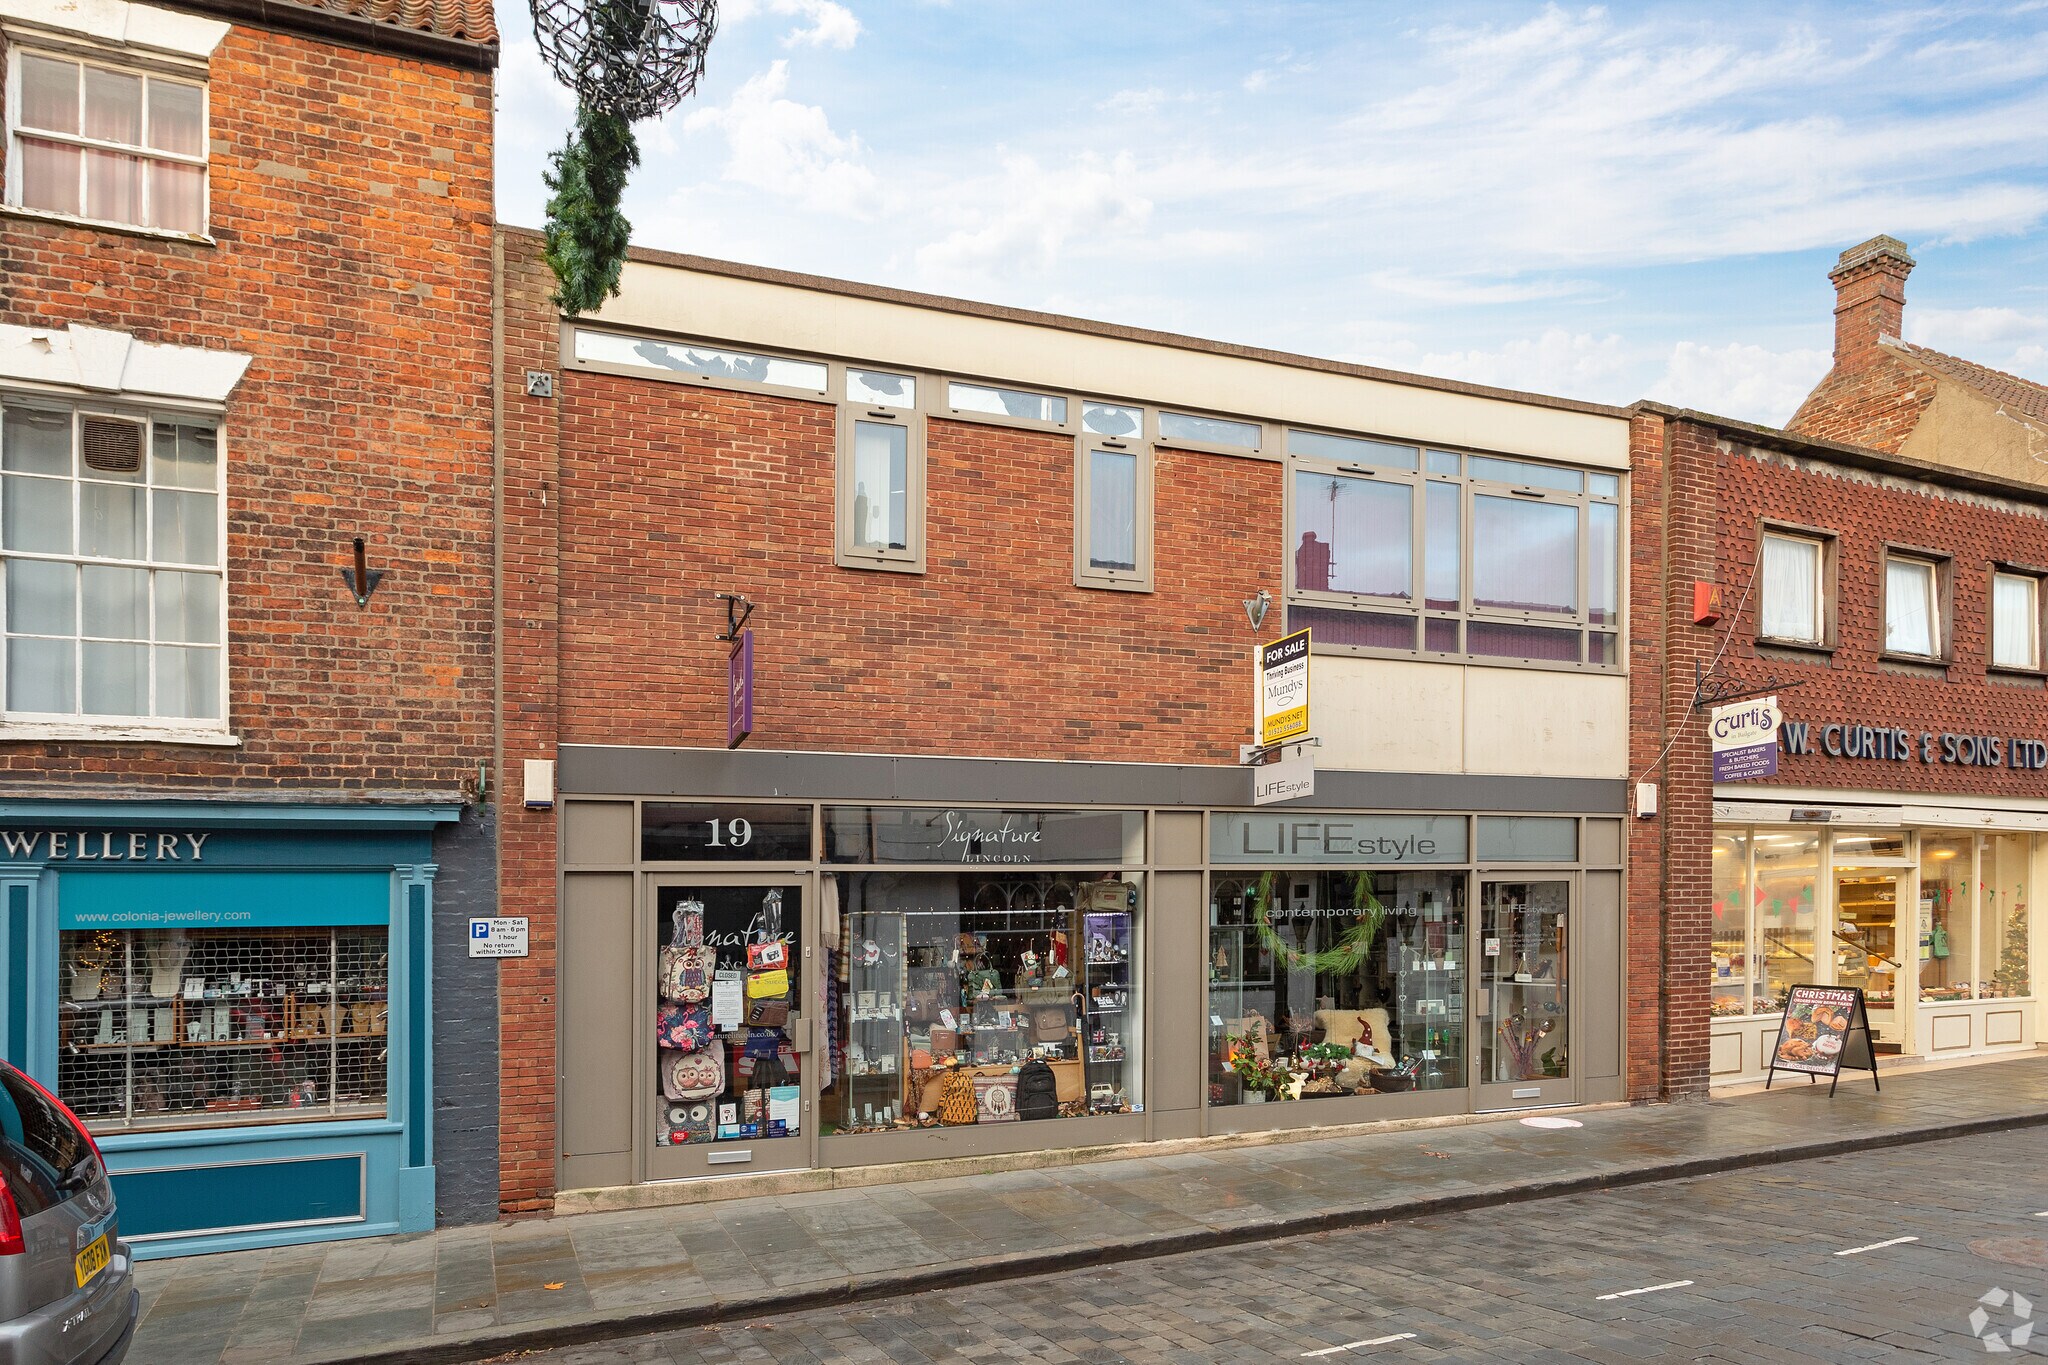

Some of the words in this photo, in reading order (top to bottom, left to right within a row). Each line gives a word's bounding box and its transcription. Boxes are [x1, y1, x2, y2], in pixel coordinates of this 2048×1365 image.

[1266, 646, 1283, 664] FOR
[1284, 638, 1305, 657] SALE
[1266, 668, 1284, 681] Thriving
[1284, 662, 1304, 674] Business
[1268, 679, 1303, 700] Mundys
[1267, 710, 1303, 728] MUNDYS.NET
[1714, 708, 1773, 738] Curtis
[1721, 749, 1746, 758] SPECIALIST
[1747, 746, 1766, 754] BAKERS
[1819, 723, 1910, 762] CURTIS
[1919, 732, 1934, 765] &
[1939, 732, 2000, 766] SONS
[2007, 738, 2048, 769] LTD
[1733, 754, 1759, 762] BUTCHERS
[1751, 759, 1770, 767] FOODS
[1747, 768, 1765, 776] CAKES
[1256, 778, 1310, 798] LIFEstyle
[704, 817, 752, 847] 19
[937, 810, 1042, 862] Signature
[1242, 822, 1436, 860] LIFEstyle
[0, 830, 211, 860] WELLERY
[966, 854, 1031, 863] LINCOLN
[75, 910, 251, 923] www.colonia-jewellery.com
[1265, 905, 1377, 919] contemporary
[1381, 903, 1417, 917] living
[475, 923, 487, 937] P
[1795, 989, 1855, 1002] CHRISTMAS
